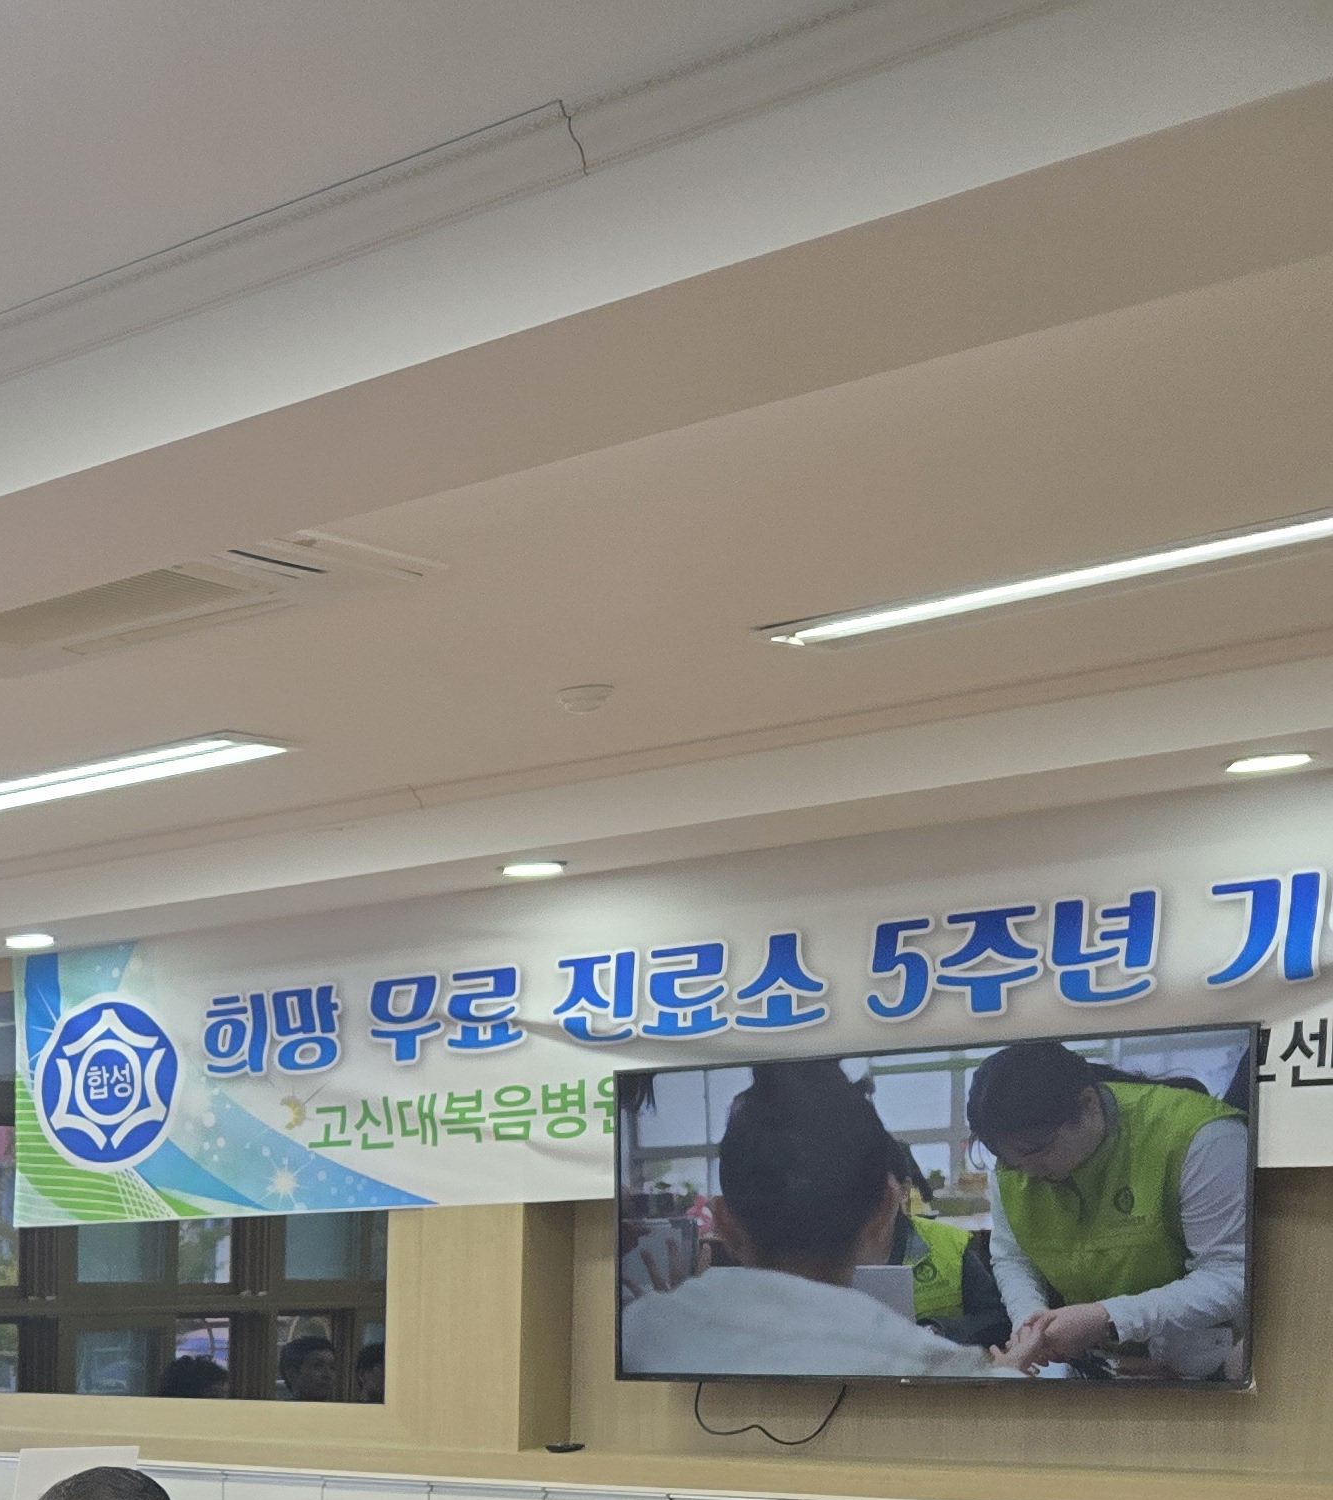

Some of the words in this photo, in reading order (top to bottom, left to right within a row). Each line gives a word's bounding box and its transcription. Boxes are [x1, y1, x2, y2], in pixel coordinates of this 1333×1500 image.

[203, 985, 339, 1074] 희망
[369, 965, 524, 1063] 무료
[552, 932, 826, 1042] 진료소
[866, 890, 1157, 1018] 5주년
[86, 1062, 133, 1100] 합성
